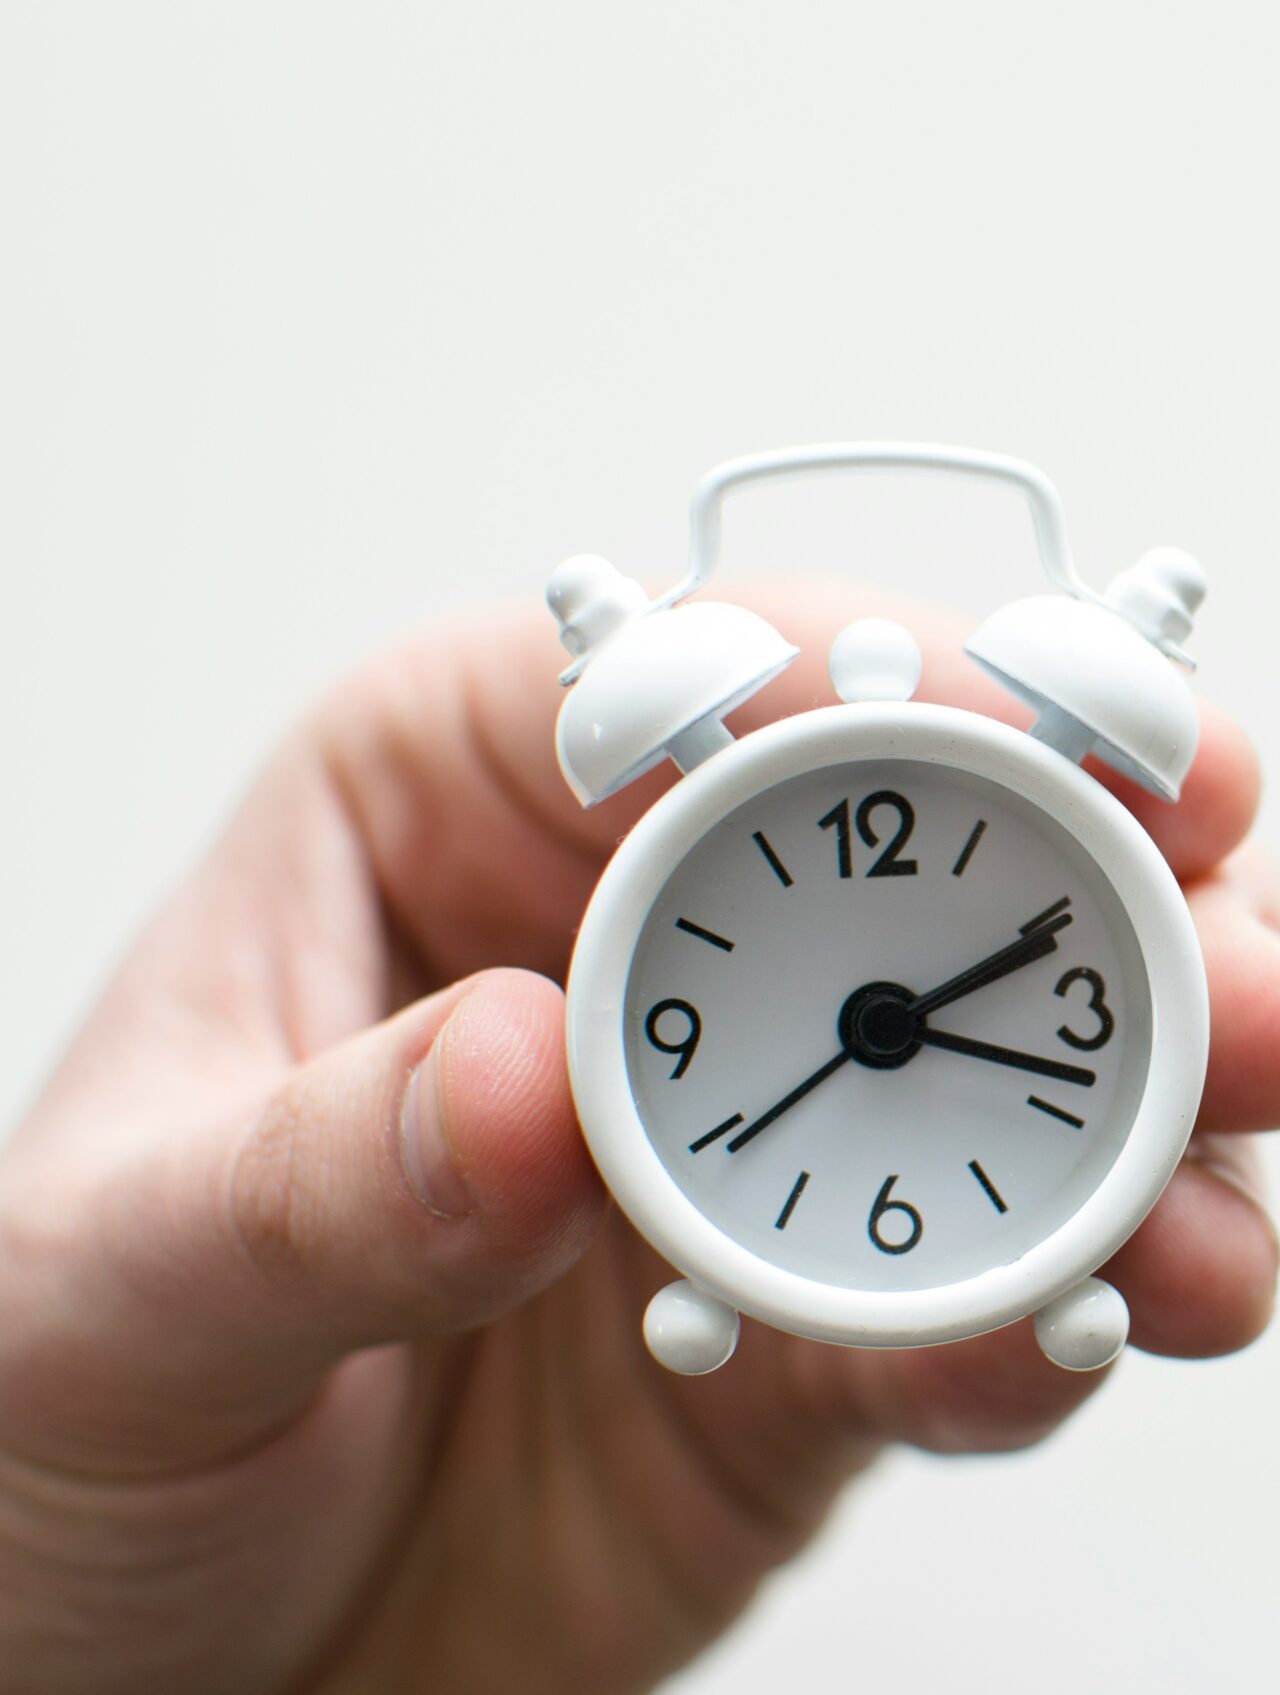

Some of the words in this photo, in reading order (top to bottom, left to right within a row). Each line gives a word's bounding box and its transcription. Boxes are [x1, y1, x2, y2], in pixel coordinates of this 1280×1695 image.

[817, 789, 918, 879] 12
[644, 998, 702, 1080] 9
[1054, 966, 1115, 1052] 3
[867, 1174, 923, 1256] 6
